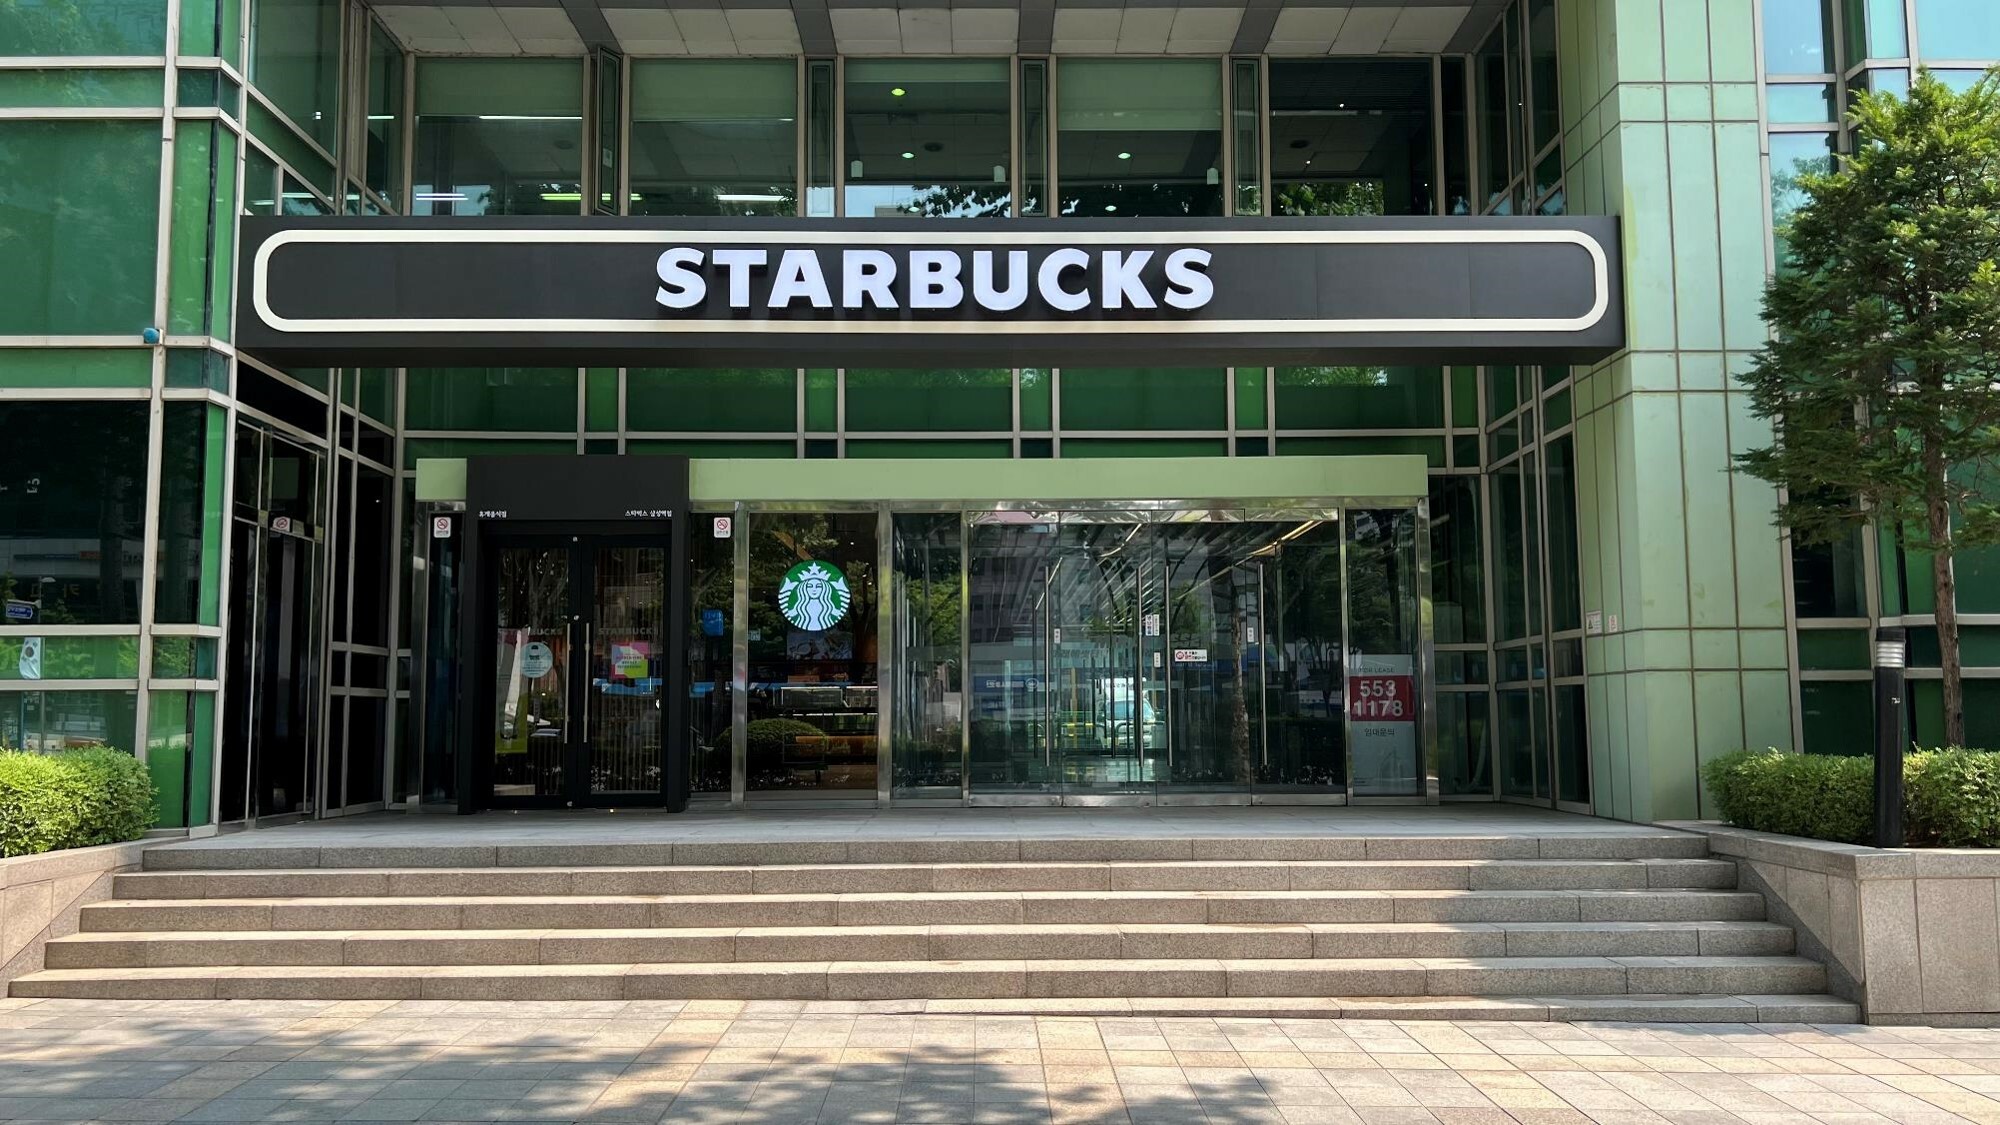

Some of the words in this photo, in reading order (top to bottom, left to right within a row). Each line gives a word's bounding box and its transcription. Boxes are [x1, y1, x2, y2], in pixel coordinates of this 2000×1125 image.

[655, 248, 1214, 311] STARBUCKS
[624, 509, 649, 518] 스타벅스
[1360, 680, 1397, 697] 553
[1353, 700, 1404, 717] 1178
[1364, 727, 1395, 737] 임대문의
